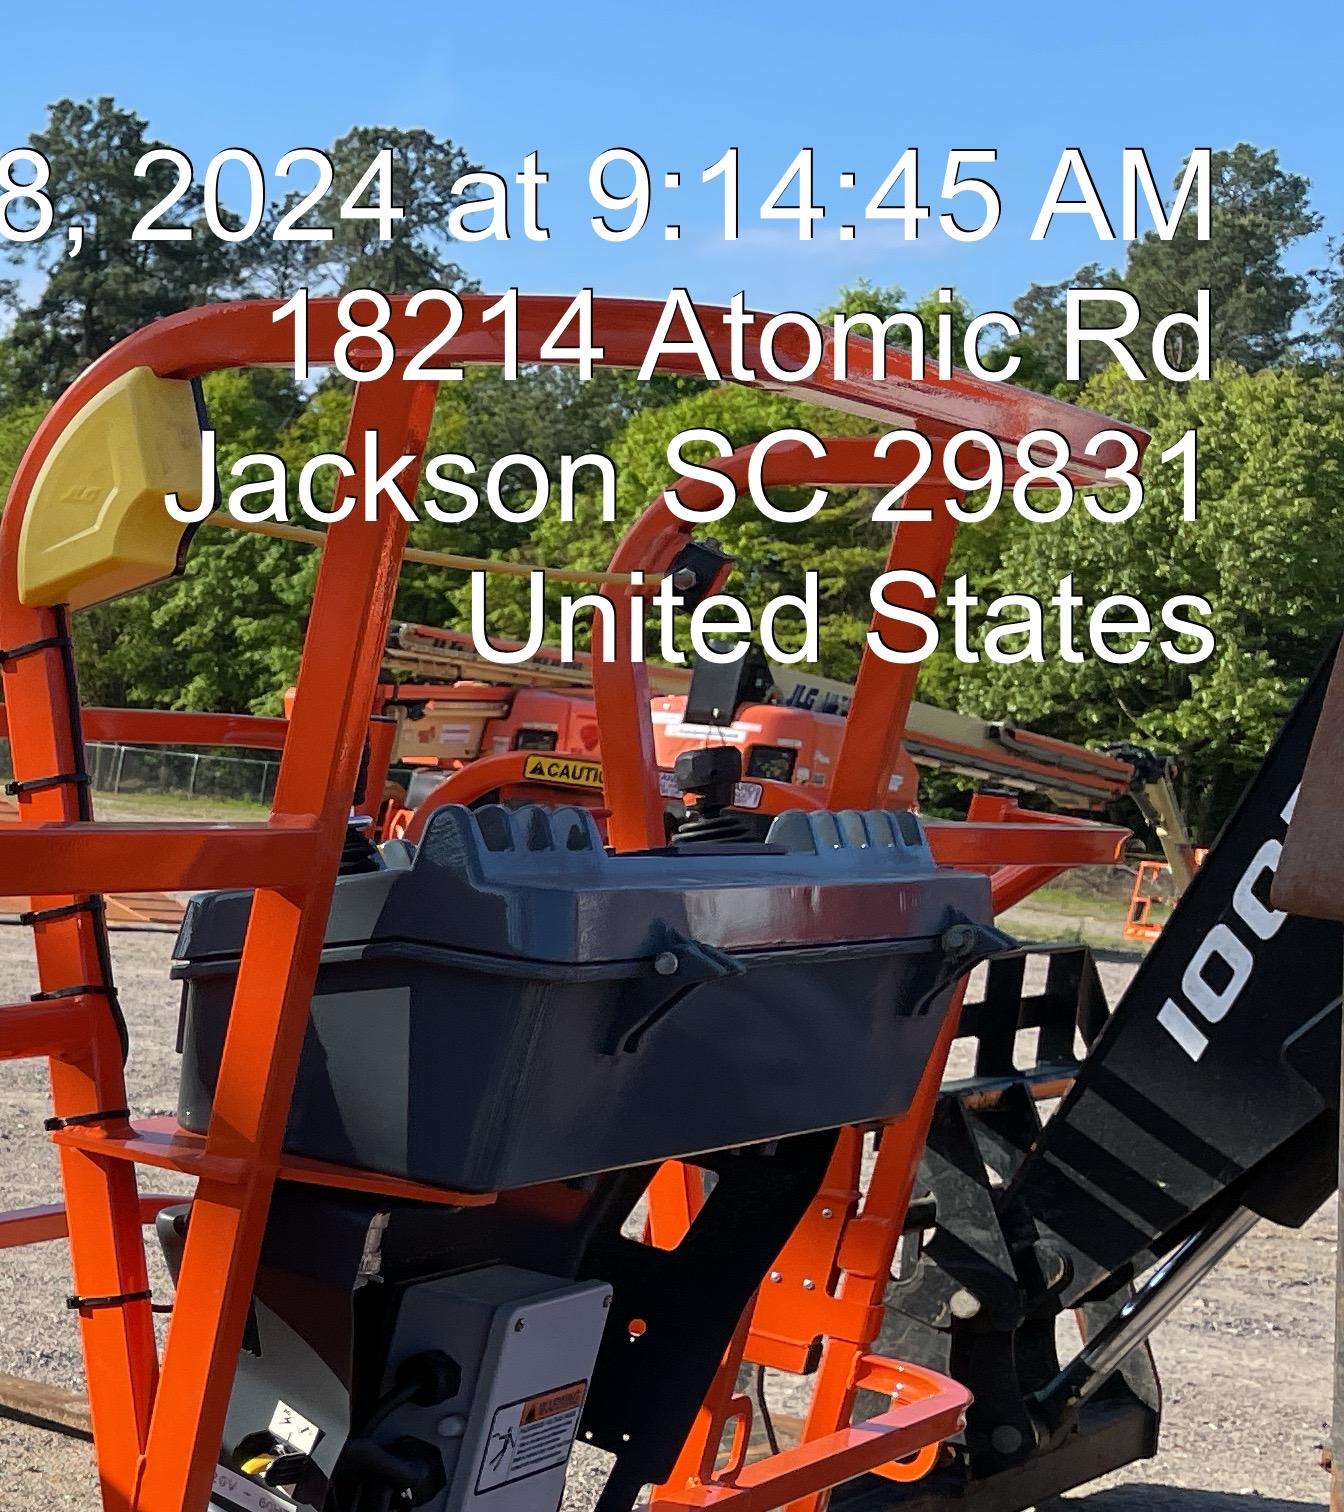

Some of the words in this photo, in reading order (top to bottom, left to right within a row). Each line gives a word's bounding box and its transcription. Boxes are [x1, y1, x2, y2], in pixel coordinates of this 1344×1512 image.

[788, 684, 820, 709] JLG
[547, 762, 604, 784] CAUTI
[1155, 782, 1302, 1063] 100
